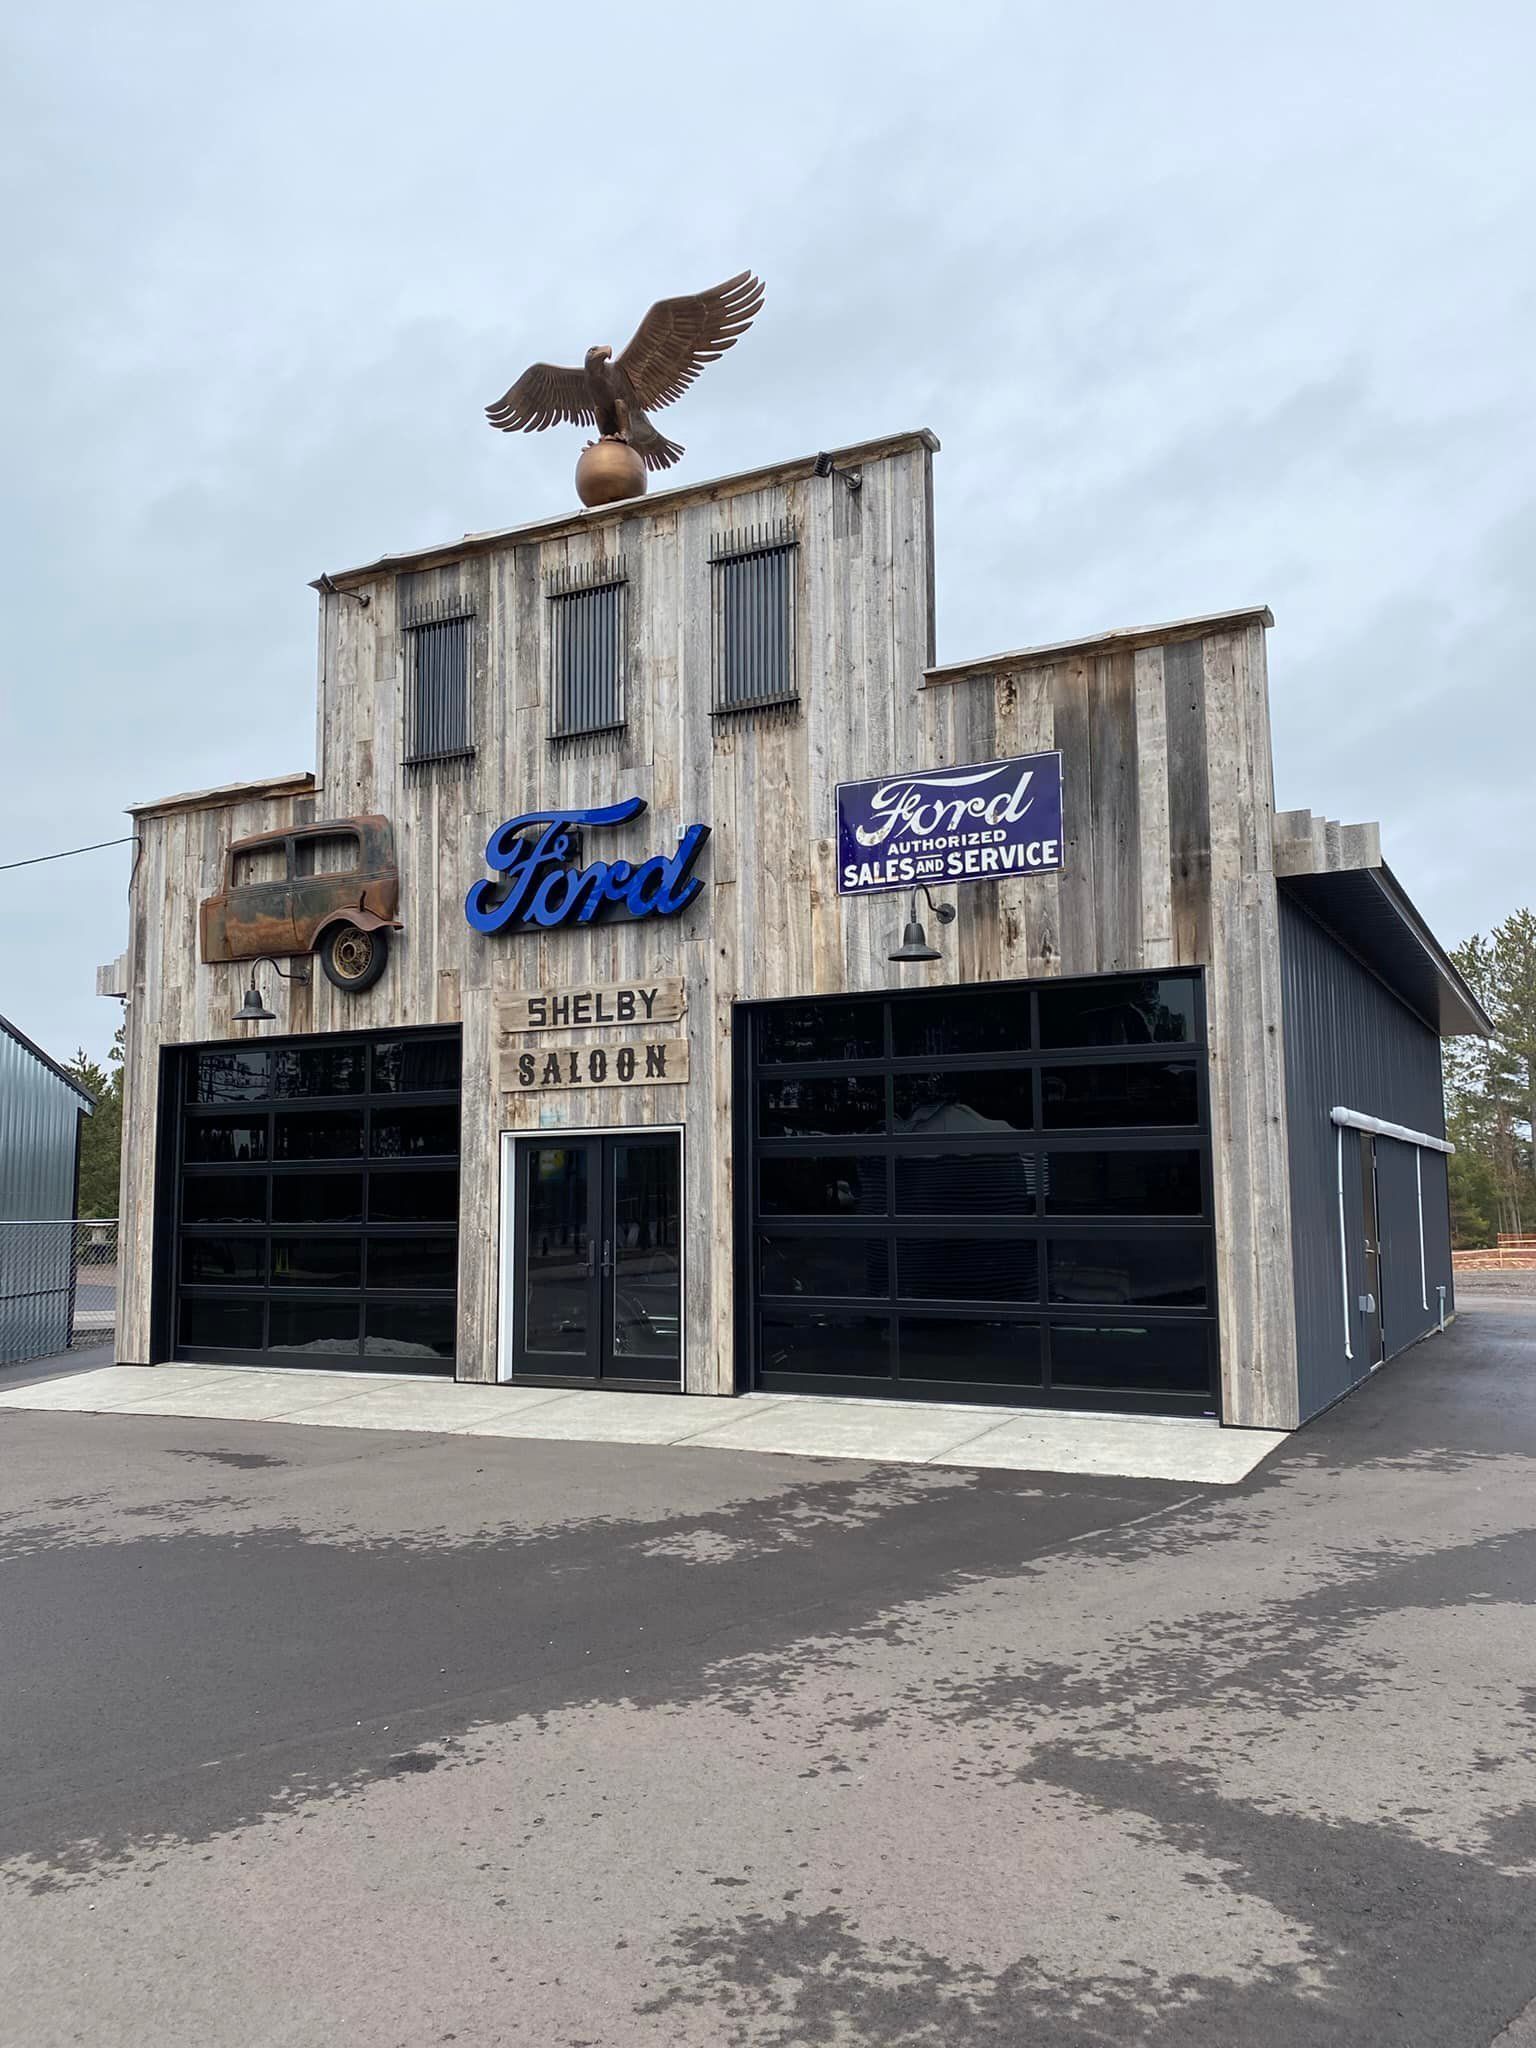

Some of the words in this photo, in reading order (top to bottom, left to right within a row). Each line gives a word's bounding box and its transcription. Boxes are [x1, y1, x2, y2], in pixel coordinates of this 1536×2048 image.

[856, 765, 1034, 846] Ford
[844, 858, 915, 887] SALES
[916, 858, 944, 874] AND
[947, 840, 1058, 875] SERVICE
[888, 830, 1006, 856] AUTHORIZED
[465, 797, 712, 935] Ford
[528, 988, 658, 1026] SHELBY
[519, 1045, 666, 1086] SALOON
